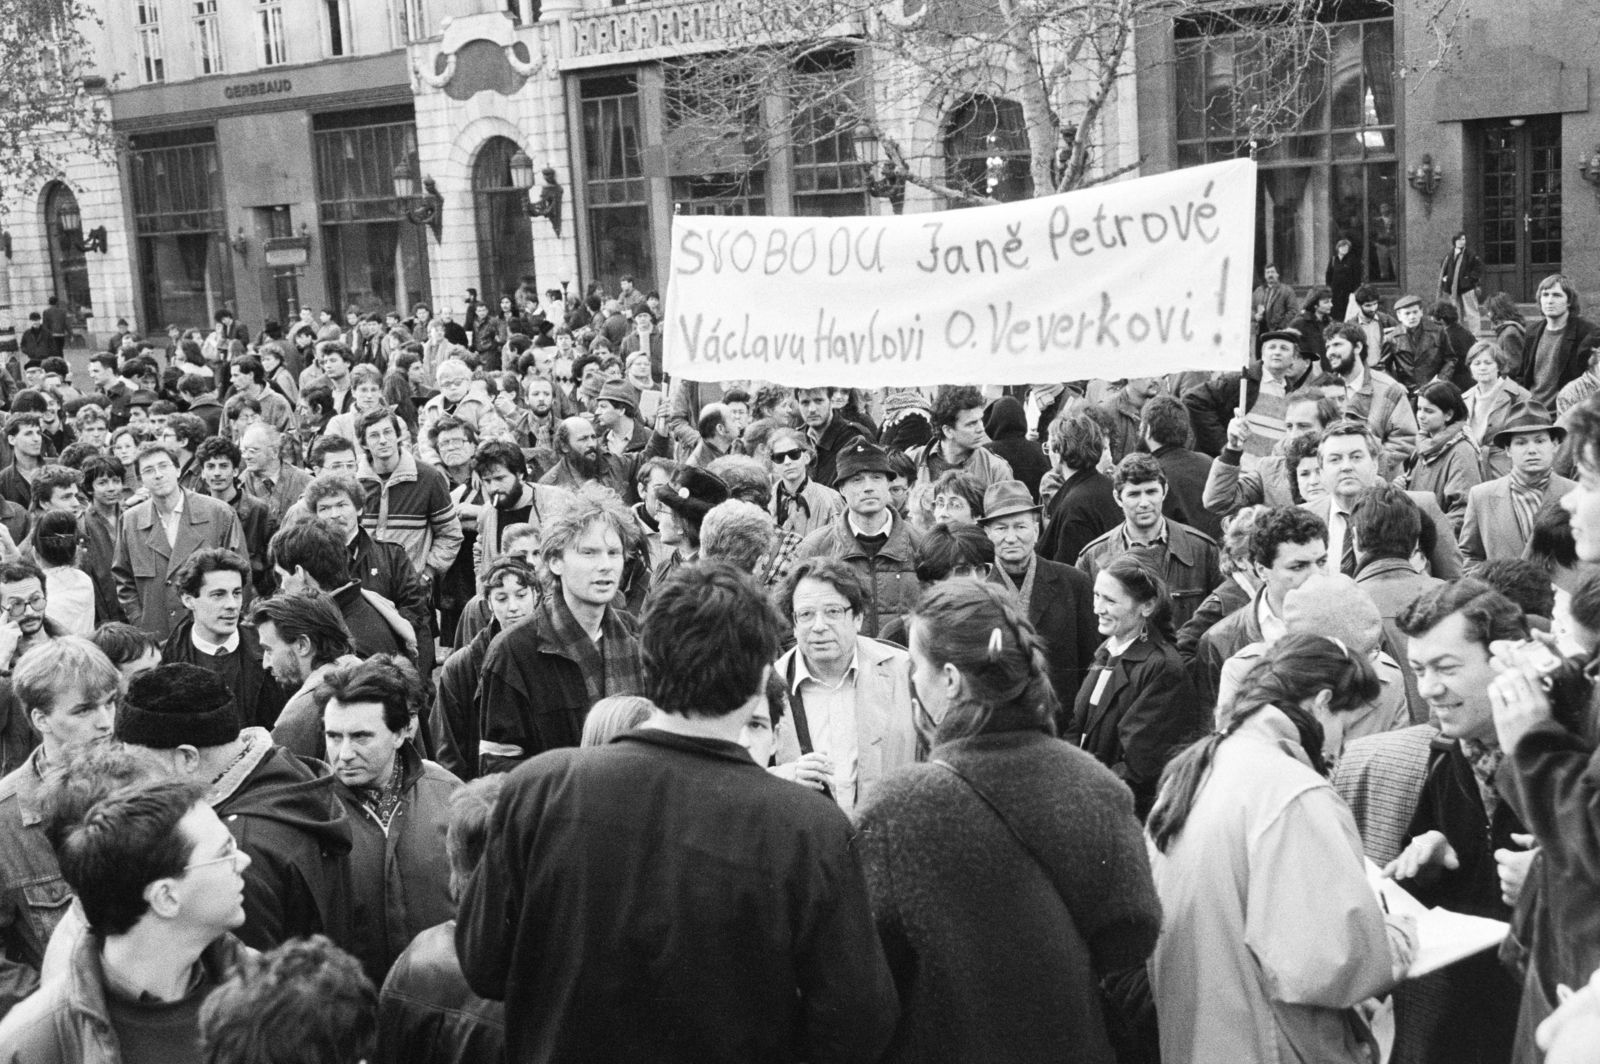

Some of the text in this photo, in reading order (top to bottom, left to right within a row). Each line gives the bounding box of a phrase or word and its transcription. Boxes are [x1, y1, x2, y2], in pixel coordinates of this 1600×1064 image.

[224, 79, 292, 99] GERBEAUD
[677, 180, 1220, 276] SVOBODU Janě Petrové
[679, 312, 805, 365] Václavu
[814, 306, 924, 364] Havlovi
